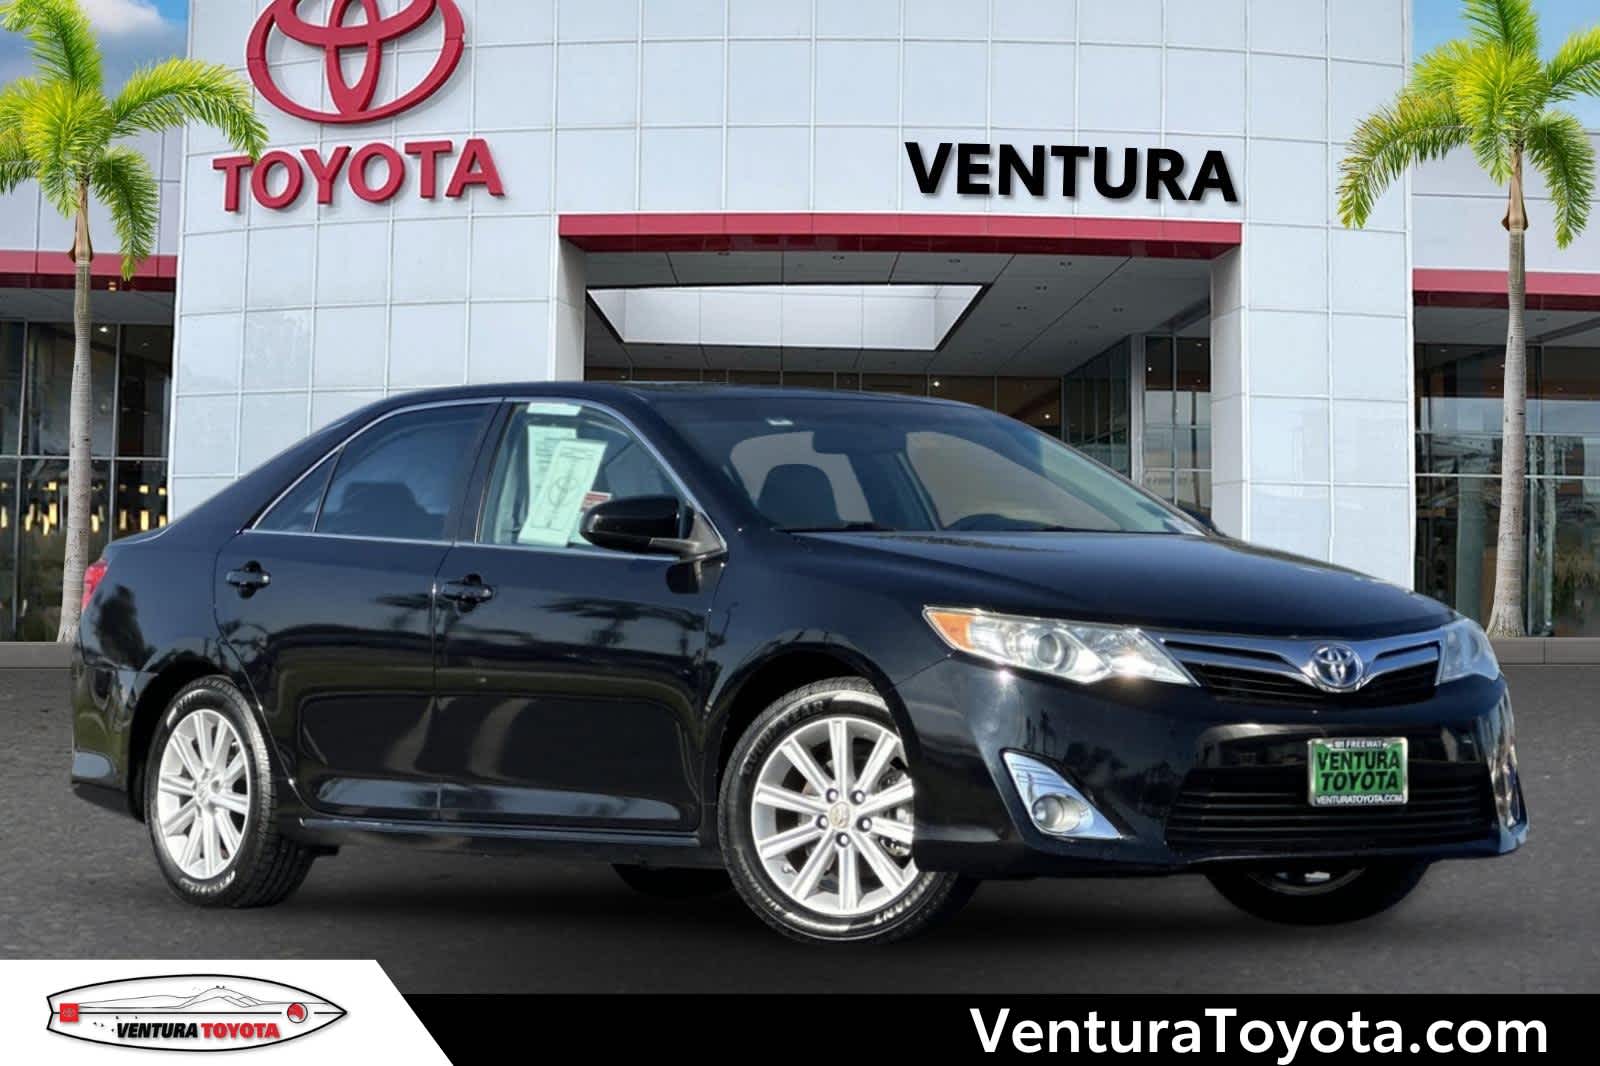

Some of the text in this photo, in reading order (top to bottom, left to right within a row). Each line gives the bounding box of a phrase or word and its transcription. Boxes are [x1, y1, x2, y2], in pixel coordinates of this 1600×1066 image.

[212, 138, 504, 212] TOYOTA
[904, 141, 1239, 203] VENTURA
[1317, 751, 1400, 770] VENTURA
[1321, 771, 1399, 791] TOYOTA
[1315, 794, 1403, 805] VENTURATOYOTA.COM
